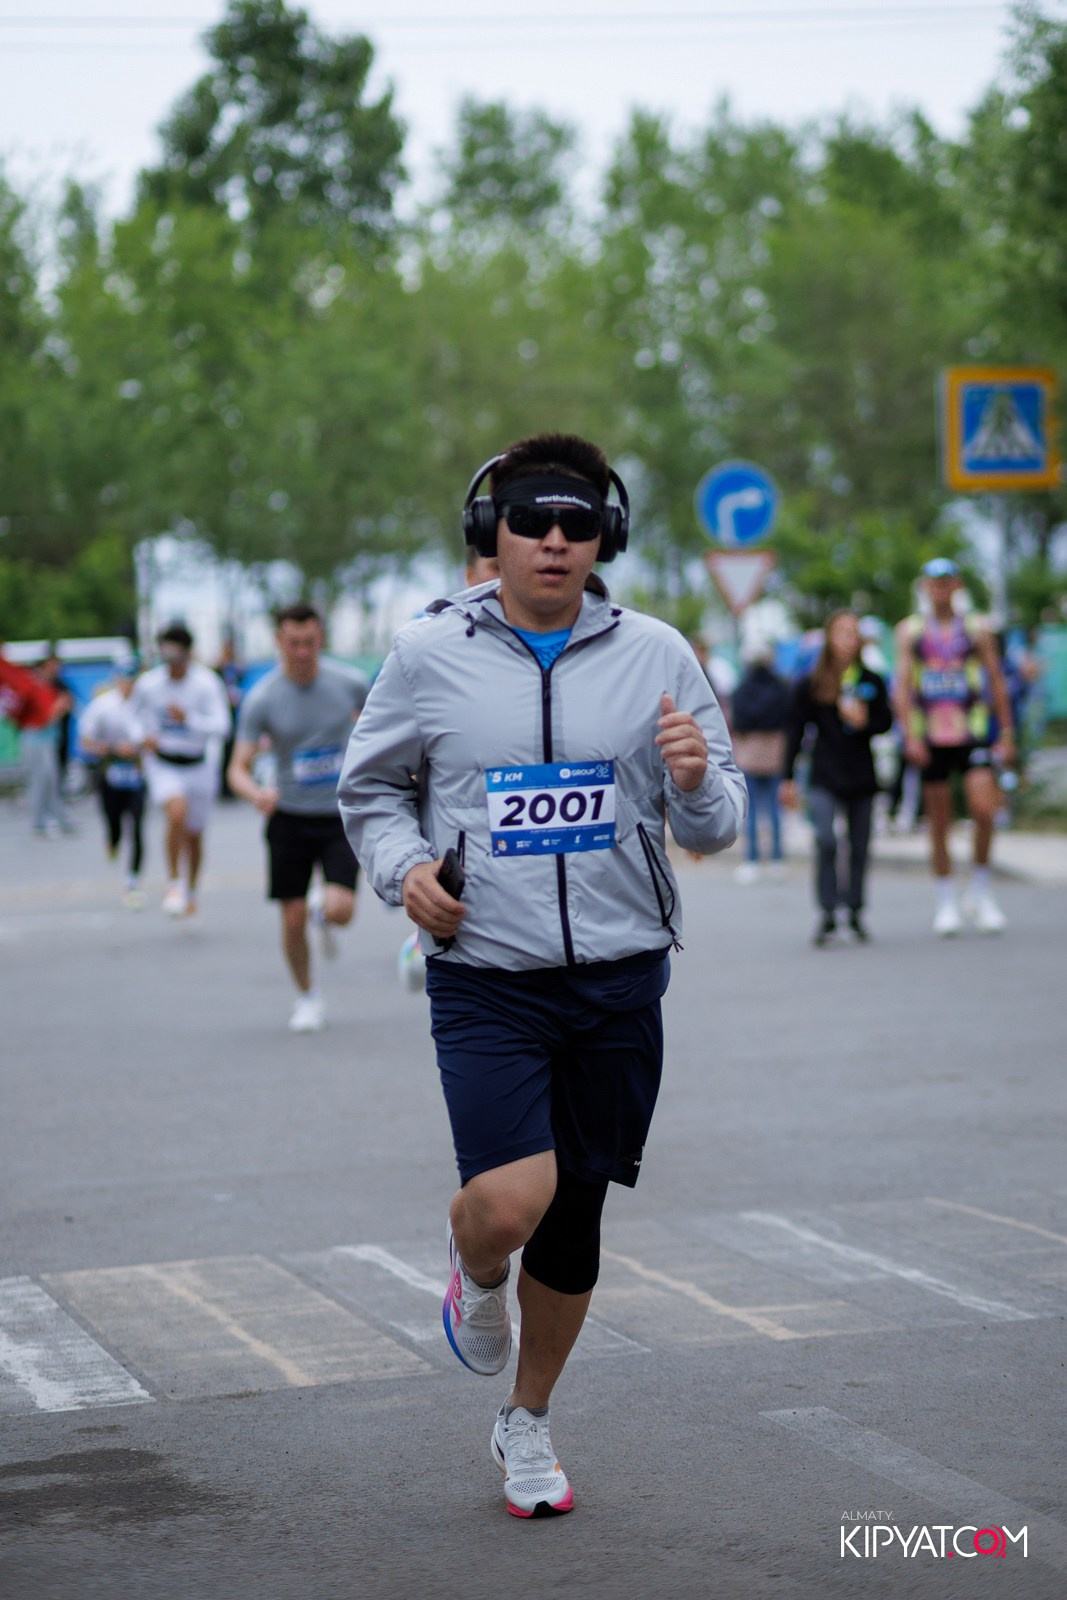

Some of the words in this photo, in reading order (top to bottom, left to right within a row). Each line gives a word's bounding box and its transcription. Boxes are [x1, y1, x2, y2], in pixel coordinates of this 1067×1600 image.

[491, 771, 502, 783] 5
[504, 772, 523, 782] KM
[571, 768, 596, 777] GROUP
[499, 789, 605, 827] 2001
